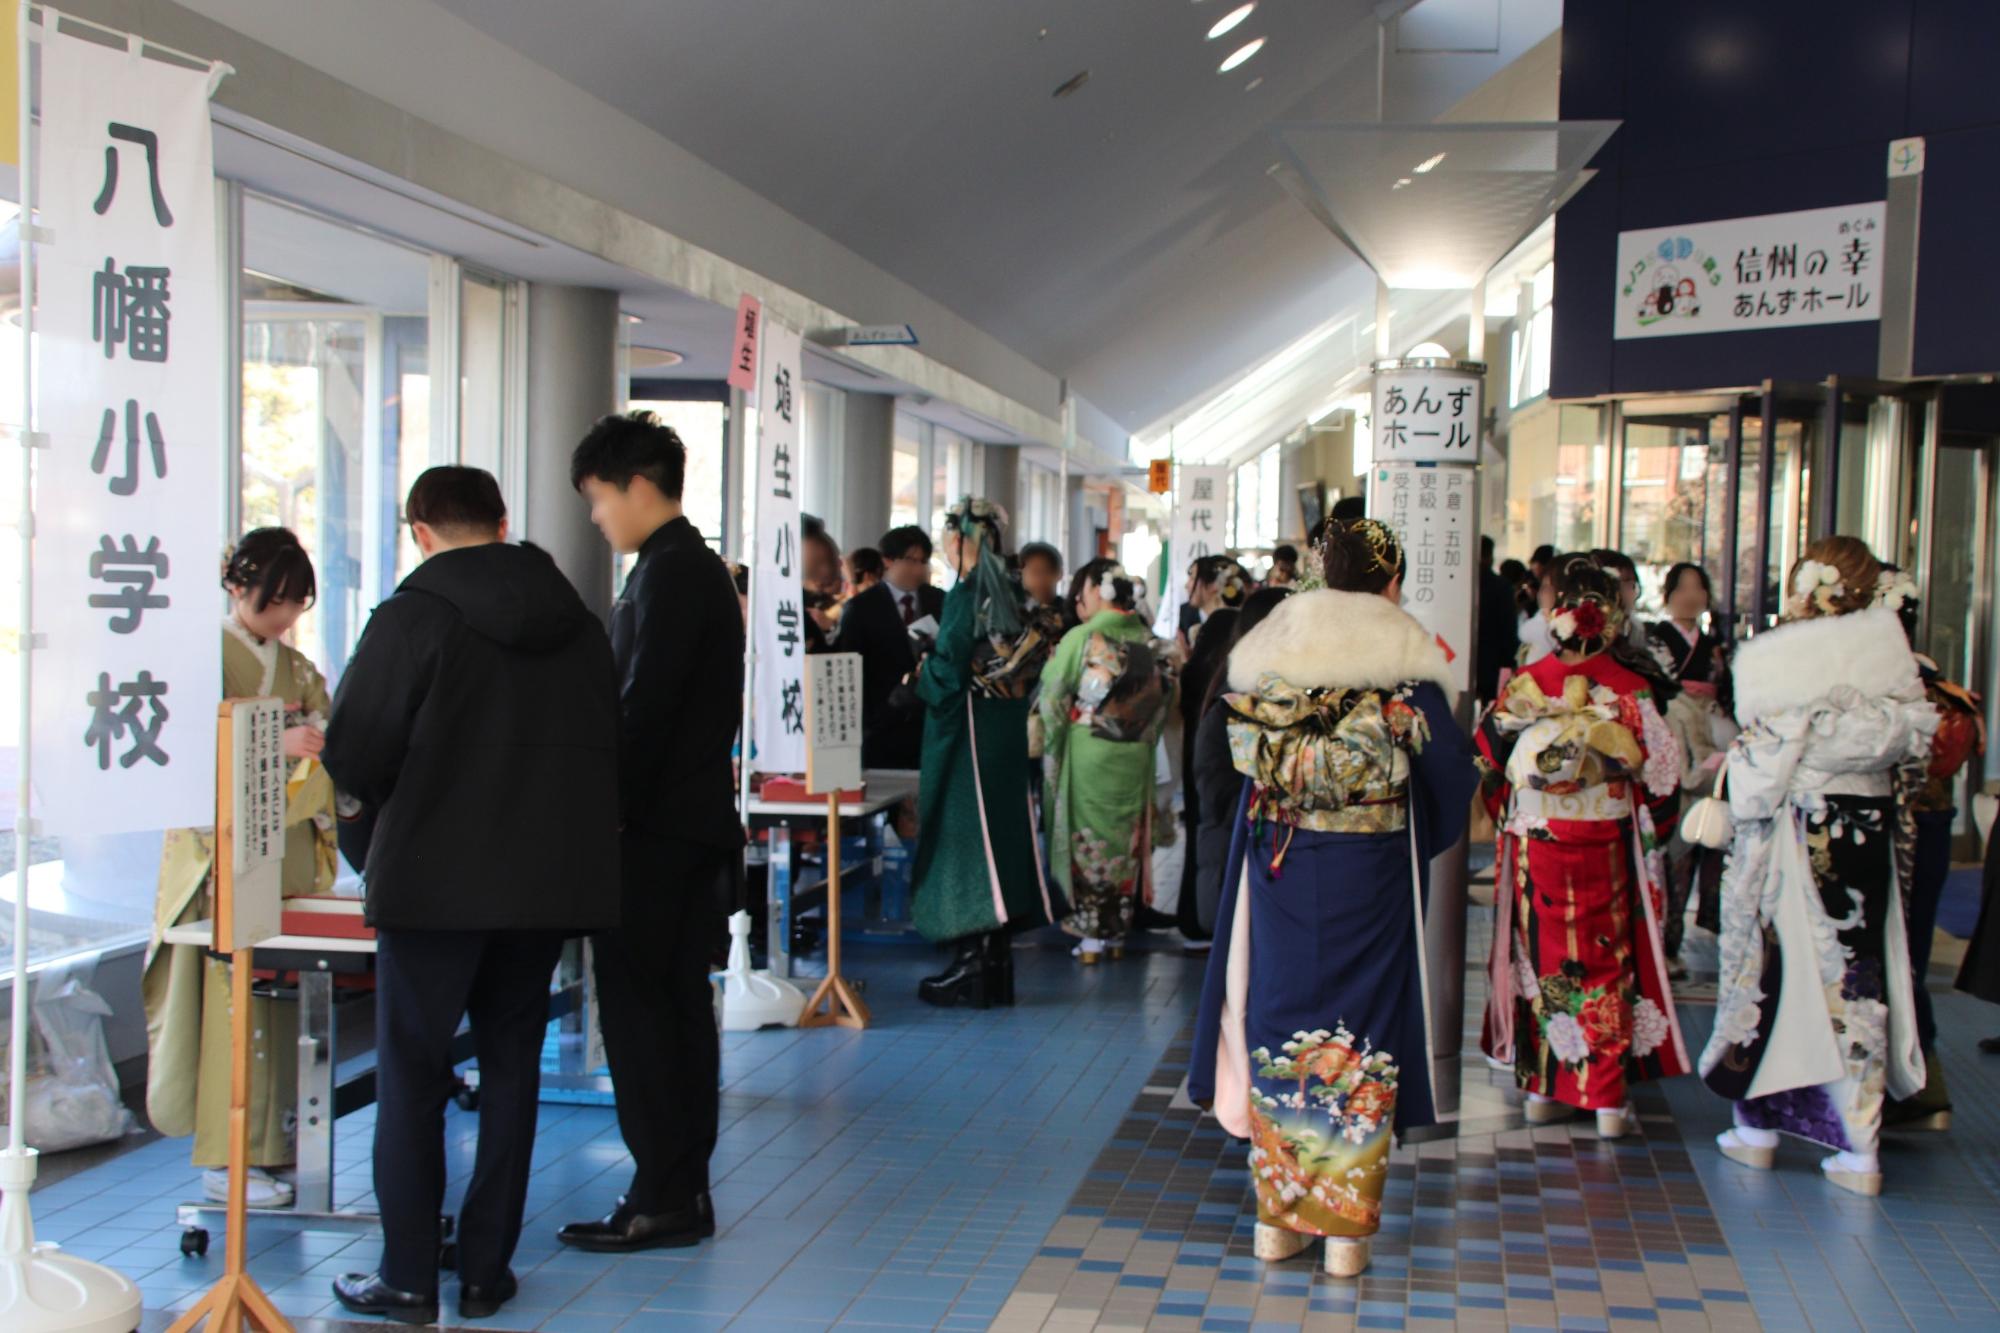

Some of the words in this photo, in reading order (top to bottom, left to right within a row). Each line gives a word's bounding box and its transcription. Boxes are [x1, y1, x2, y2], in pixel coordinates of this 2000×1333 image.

[1839, 217, 1876, 235] めぐみ
[1734, 237, 1871, 285] 信州の幸
[1733, 283, 1870, 319] あんずホール
[1383, 385, 1472, 417] あんず
[85, 122, 173, 771] 八幡小学校
[1383, 419, 1471, 449] ホール
[1416, 473, 1437, 604] 更級・上山田の
[1444, 473, 1462, 580] 戸倉・五加・
